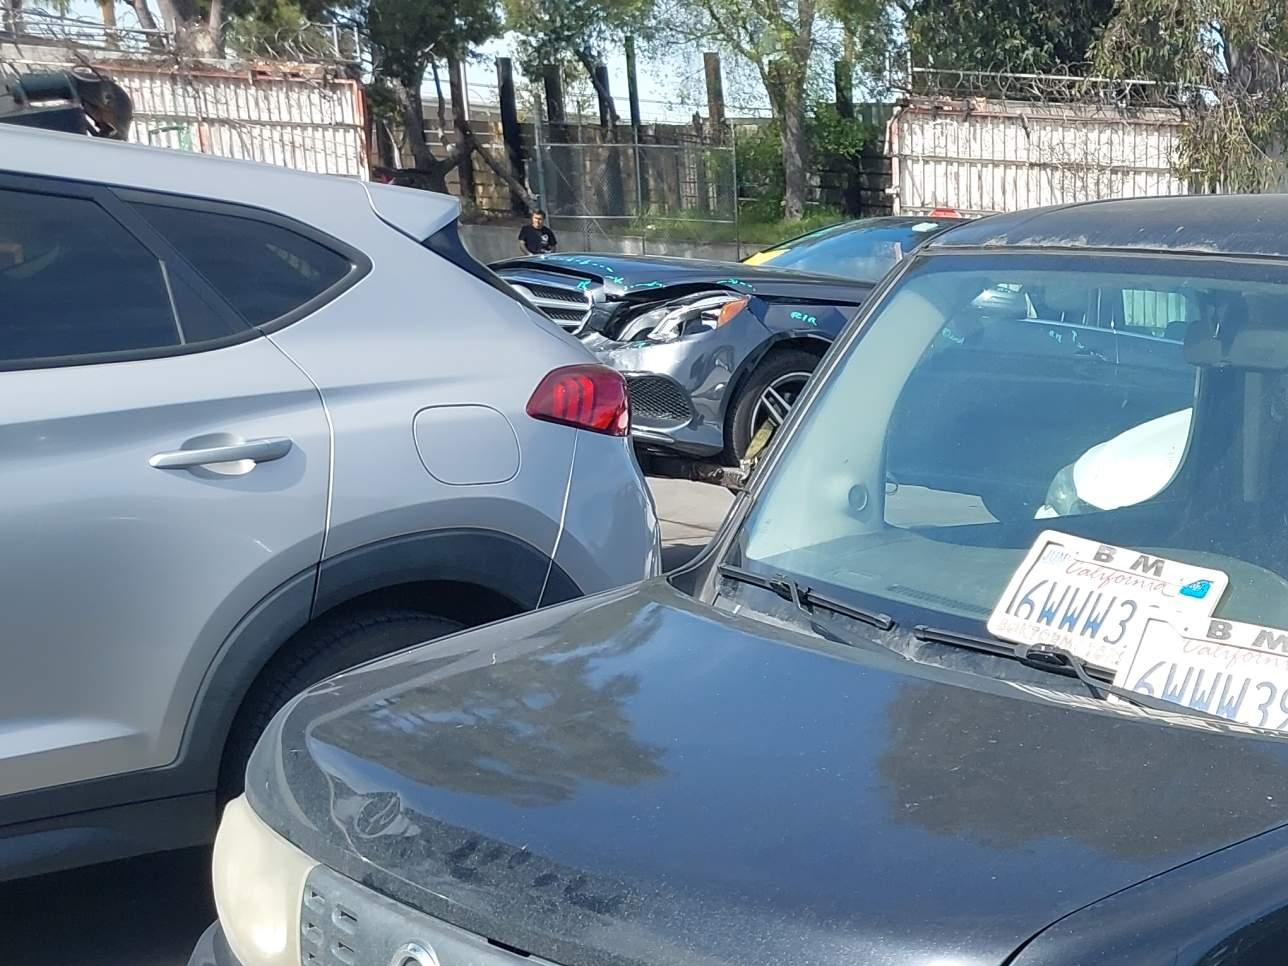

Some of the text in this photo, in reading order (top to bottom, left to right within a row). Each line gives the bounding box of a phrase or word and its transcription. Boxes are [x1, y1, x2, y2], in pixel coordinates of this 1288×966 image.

[1092, 544, 1165, 577] B M
[1014, 579, 1183, 645] 6WWW3
[1207, 620, 1233, 640] B
